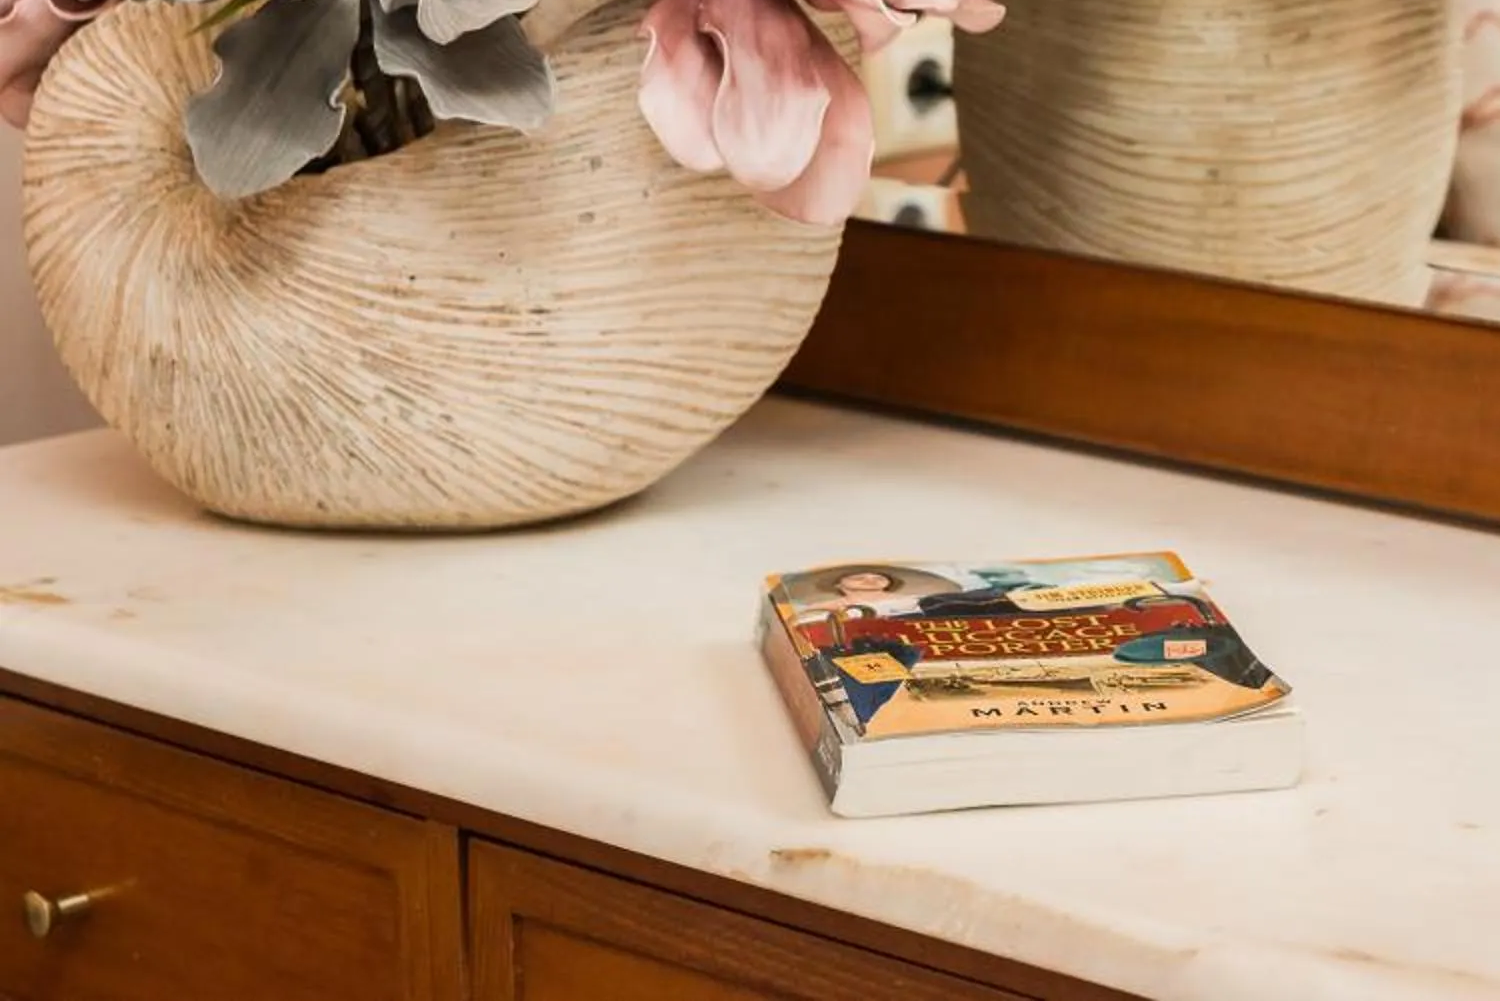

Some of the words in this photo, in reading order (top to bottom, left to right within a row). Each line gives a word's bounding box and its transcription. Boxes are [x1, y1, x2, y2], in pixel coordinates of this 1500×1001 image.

[904, 619, 969, 633] THE
[979, 614, 1109, 631] LOST
[896, 624, 1142, 646] LUGGAGE
[929, 638, 1118, 656] PORTER
[971, 702, 1167, 717] MARTIN
